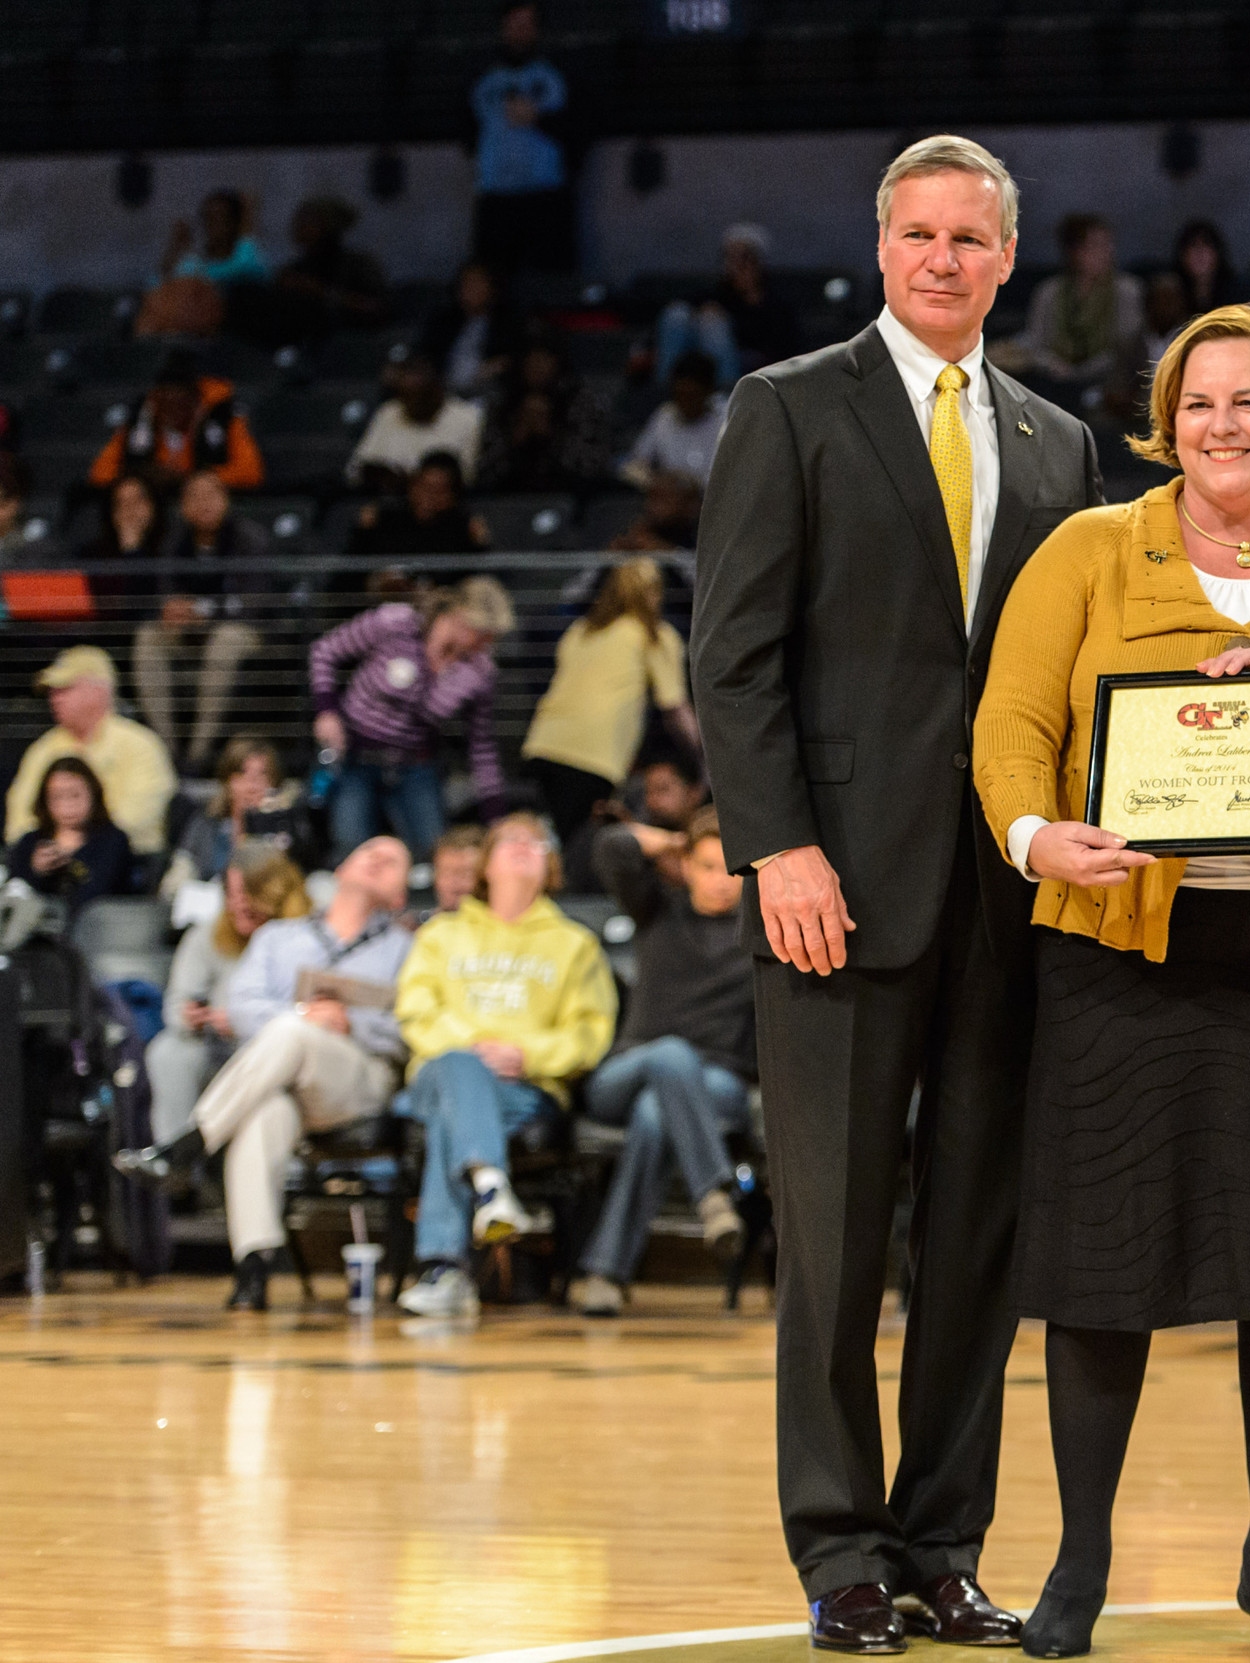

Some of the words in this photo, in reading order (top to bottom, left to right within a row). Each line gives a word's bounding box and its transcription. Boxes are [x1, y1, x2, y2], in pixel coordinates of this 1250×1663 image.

[1177, 702, 1223, 729] GT
[1170, 745, 1213, 758] Andrea
[1185, 763, 1204, 773] Class
[1139, 777, 1193, 789] WOMEN
[1196, 776, 1228, 787] OUT
